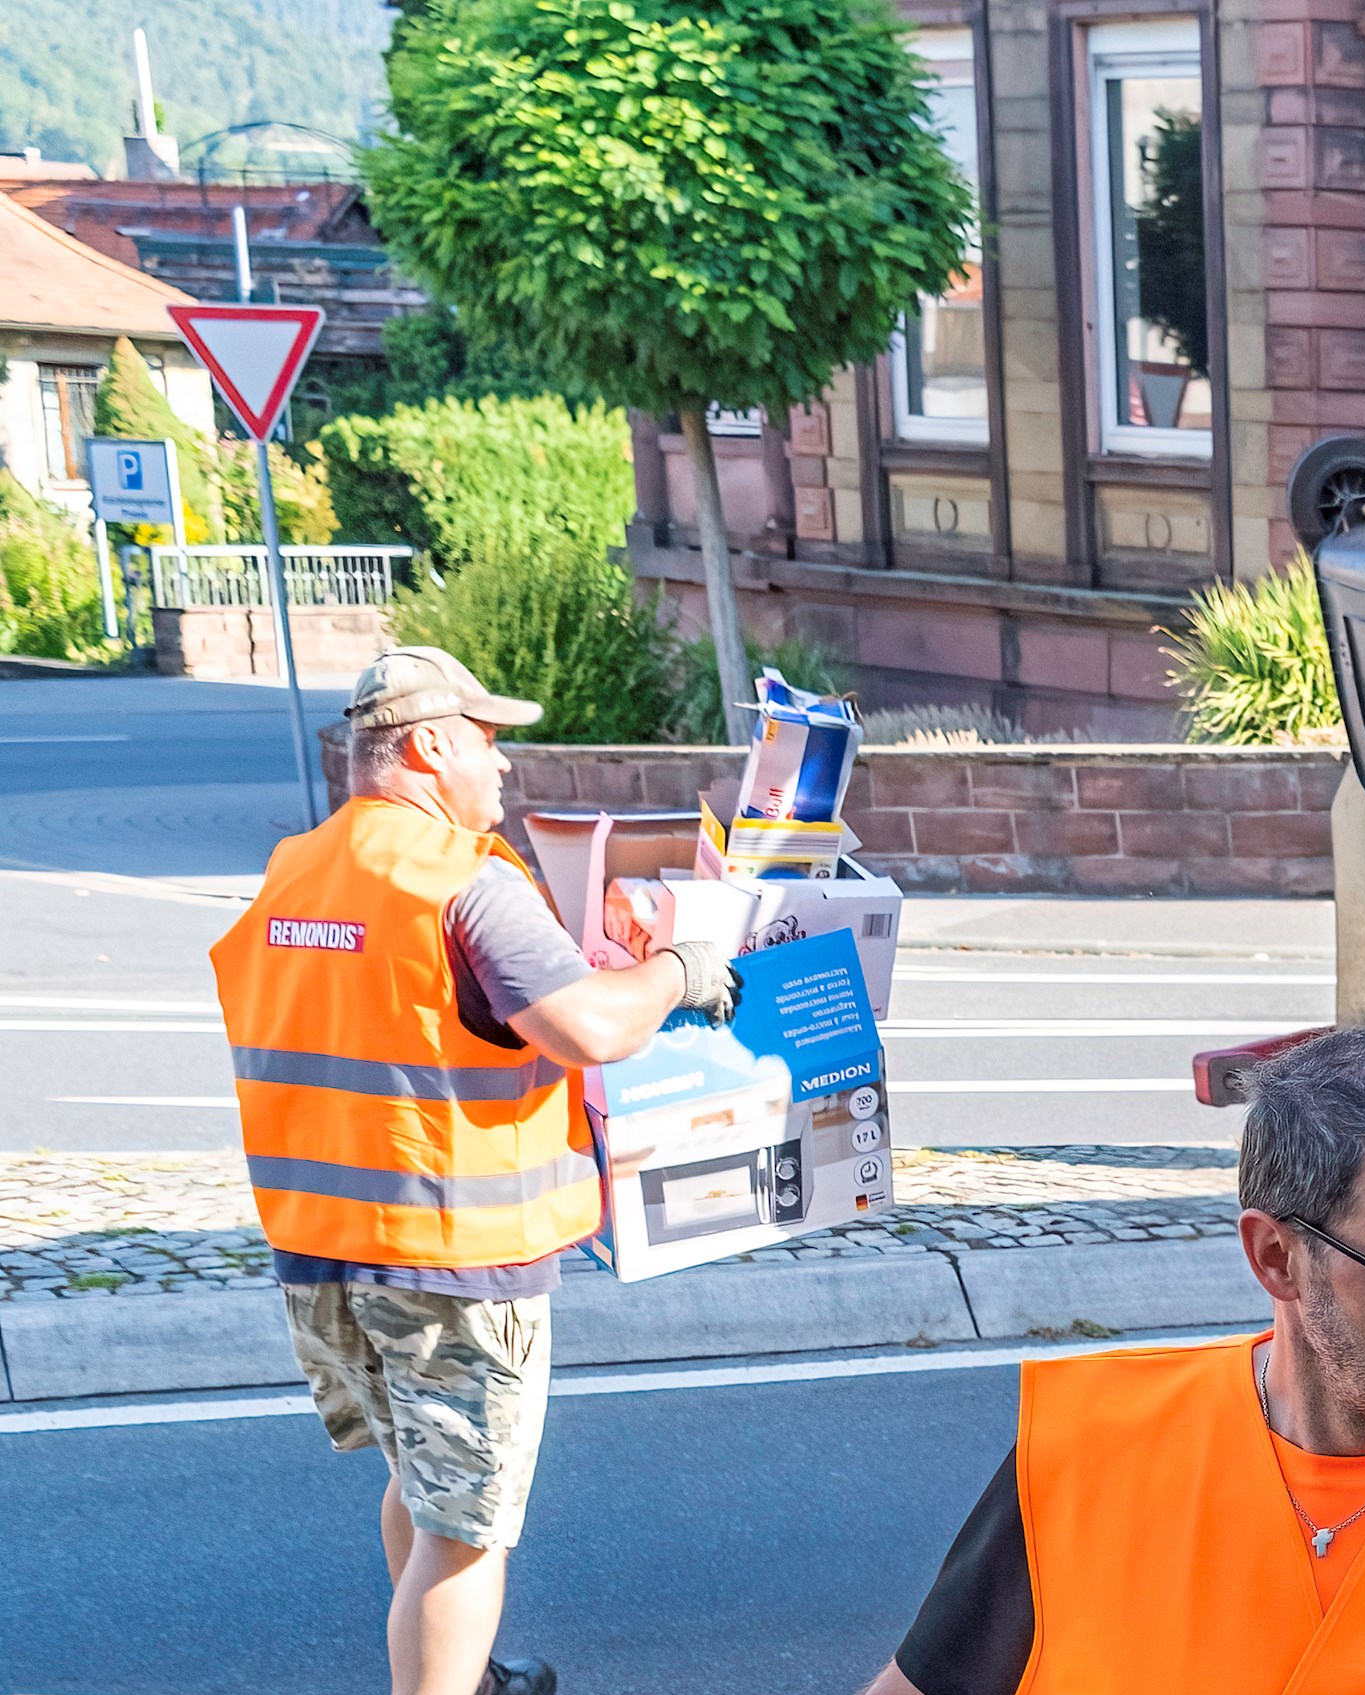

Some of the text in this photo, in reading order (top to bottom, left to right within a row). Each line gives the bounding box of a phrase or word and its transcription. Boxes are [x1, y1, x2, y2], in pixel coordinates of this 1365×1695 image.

[119, 453, 139, 490] P
[765, 788, 785, 819] Bull
[269, 918, 358, 951] REMONDIS
[801, 1062, 871, 1092] MEDION
